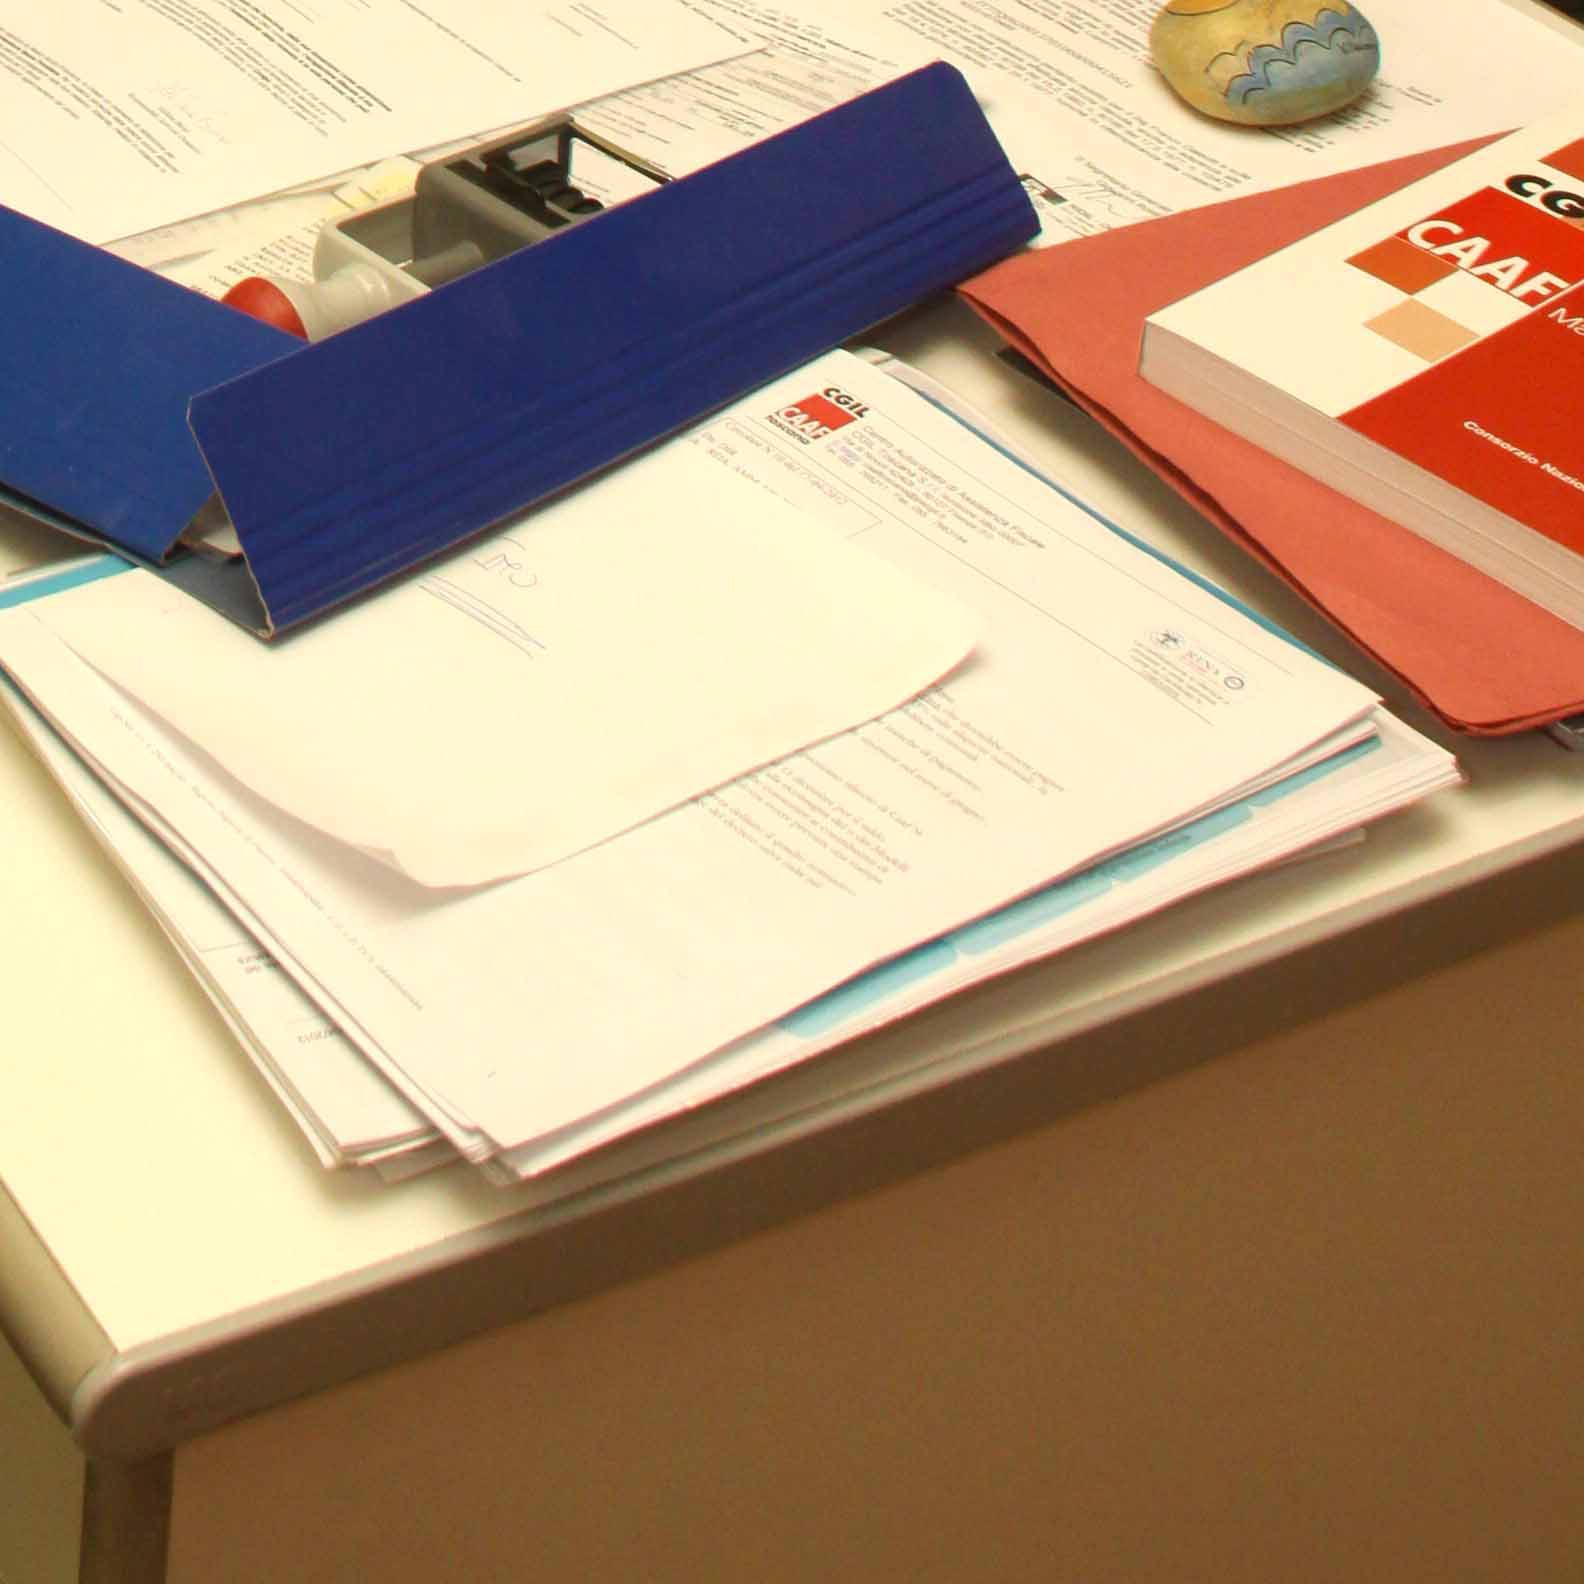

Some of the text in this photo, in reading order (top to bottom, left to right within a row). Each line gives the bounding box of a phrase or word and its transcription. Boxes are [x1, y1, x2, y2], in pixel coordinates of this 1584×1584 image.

[1408, 219, 1571, 298] CAAF
[823, 387, 870, 419] CGIL
[777, 406, 829, 440] CAAF
[1464, 421, 1539, 464] Consorzio
